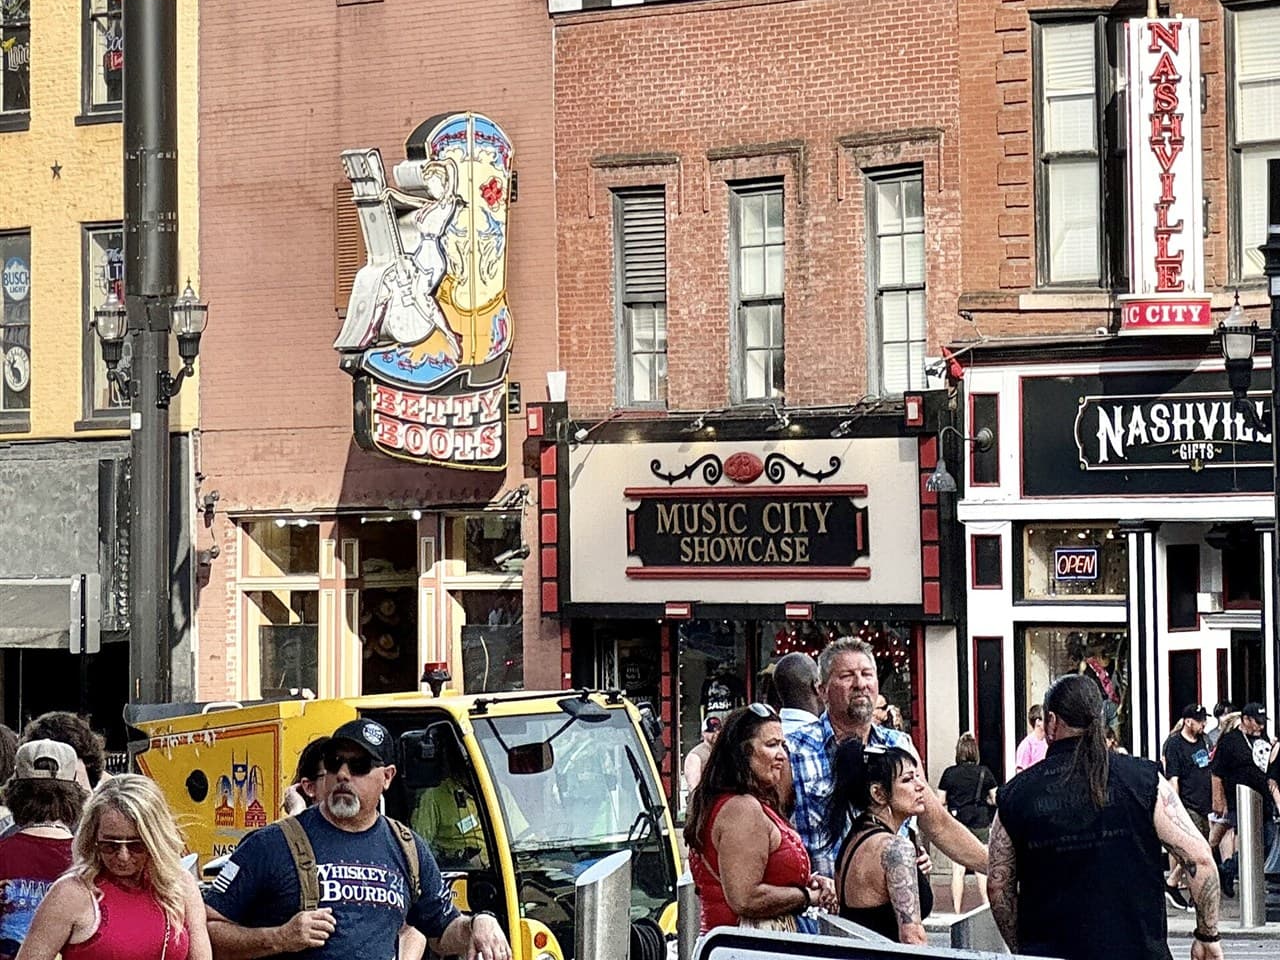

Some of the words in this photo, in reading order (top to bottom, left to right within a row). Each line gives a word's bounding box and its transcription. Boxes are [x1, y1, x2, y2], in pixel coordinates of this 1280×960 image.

[1147, 20, 1185, 294] NASHVILLE
[9, 286, 26, 294] LIGHT
[1145, 304, 1203, 323] CITY
[373, 384, 504, 426] BETTY
[375, 414, 502, 461] BOOTS
[1096, 401, 1273, 464] NASHVILL
[1178, 443, 1215, 461] GIFTS
[656, 503, 748, 536] MUSIC
[762, 502, 833, 535] CITY
[679, 536, 810, 563] SHOWCASE
[1057, 554, 1095, 575] OPEN
[213, 843, 237, 857] NAS
[315, 864, 388, 882] WHISKEY
[319, 880, 405, 909] BOURBON
